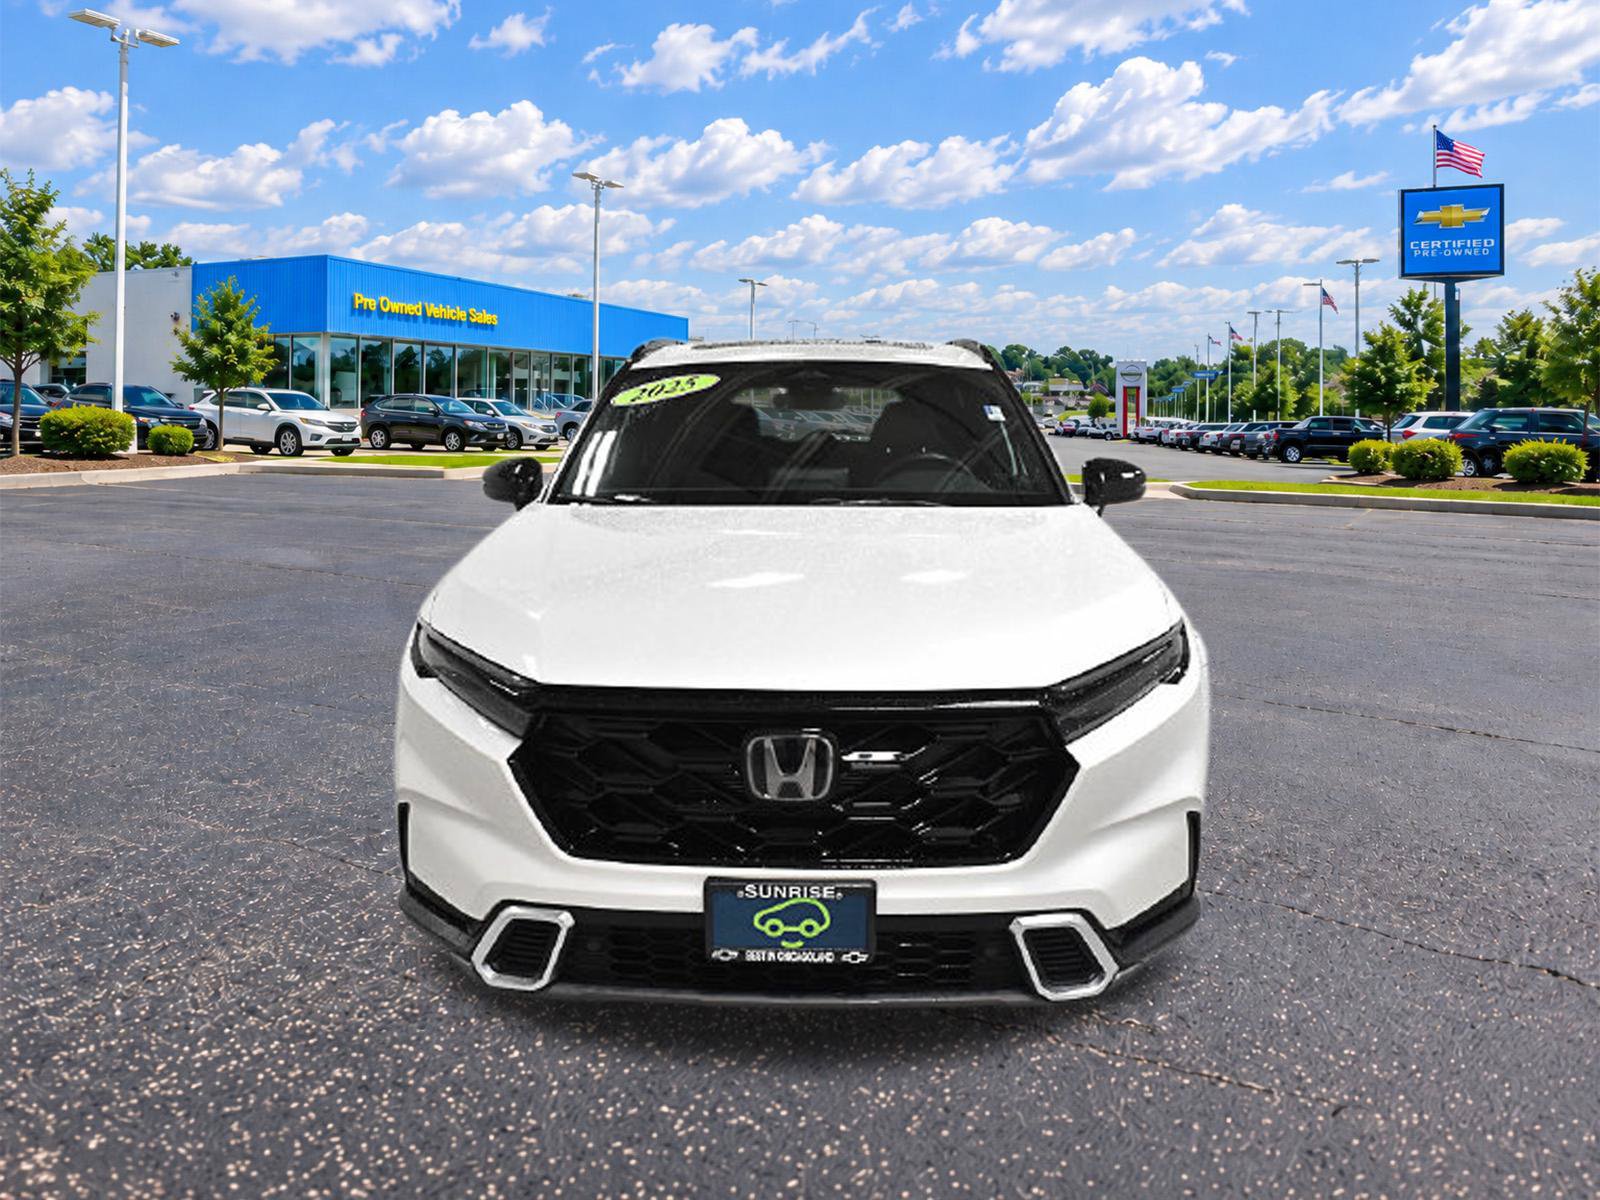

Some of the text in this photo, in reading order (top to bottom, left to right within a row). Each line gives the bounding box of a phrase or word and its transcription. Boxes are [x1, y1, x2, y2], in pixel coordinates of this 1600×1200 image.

[1410, 239, 1495, 249] CERTIFIED
[1413, 248, 1489, 257] PRE-OWNED
[353, 292, 499, 326] Pre Owned Vehicle Sales
[744, 884, 836, 899] SUNRISE
